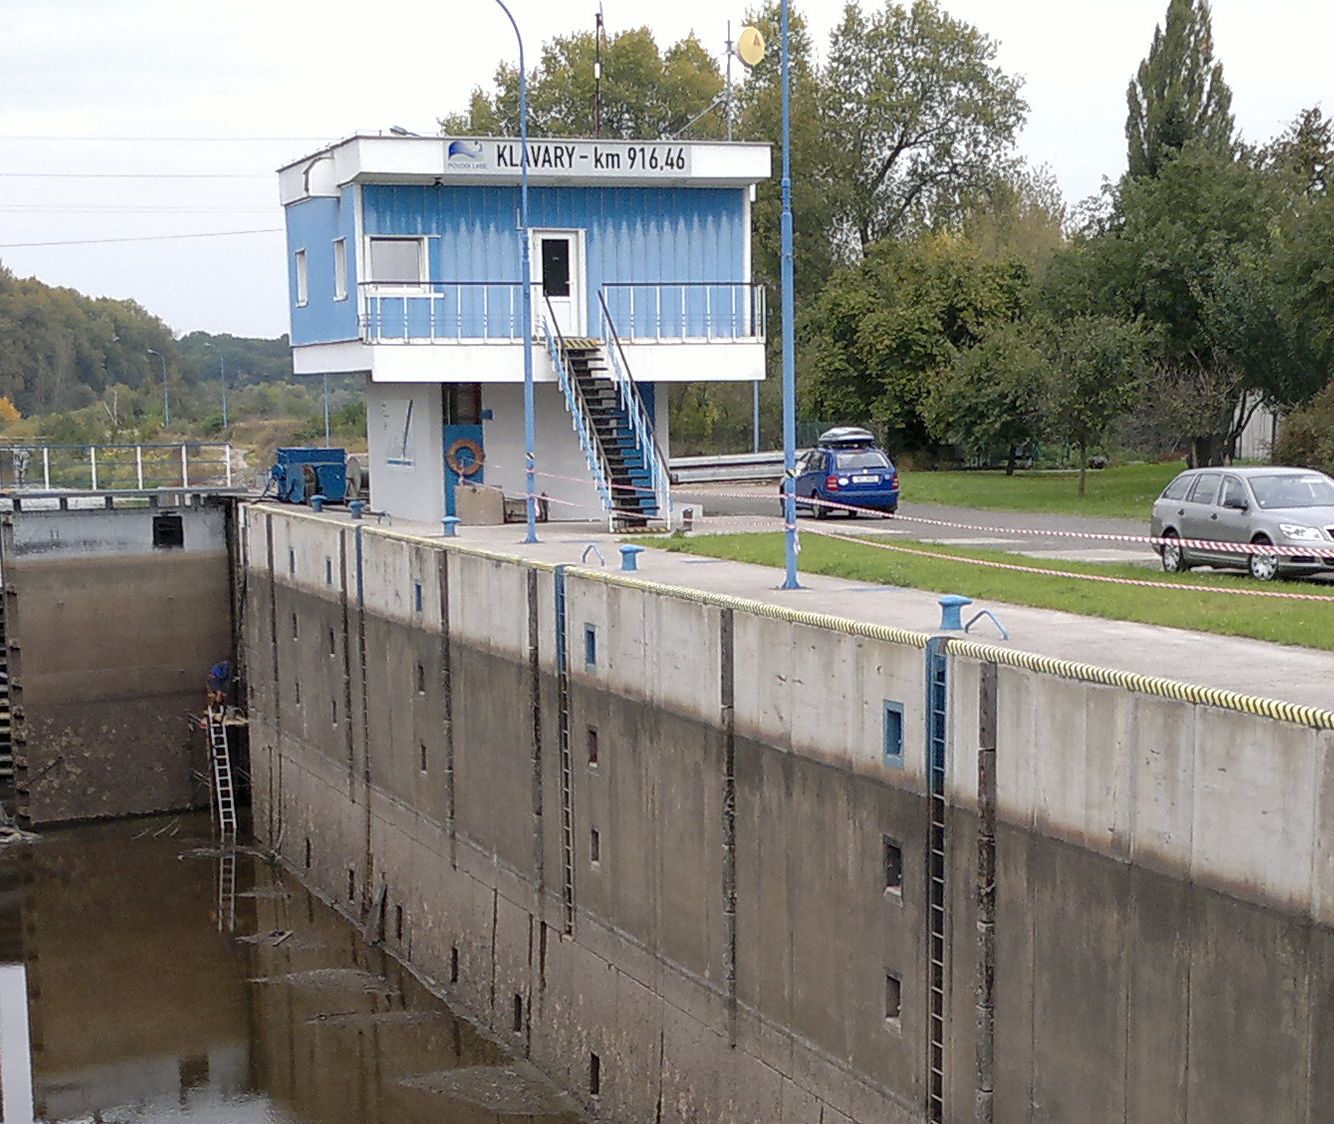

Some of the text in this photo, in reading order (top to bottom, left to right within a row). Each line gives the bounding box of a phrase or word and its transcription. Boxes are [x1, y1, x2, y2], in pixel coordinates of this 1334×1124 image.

[497, 144, 576, 168] KLAVARY
[594, 146, 620, 168] km
[628, 147, 685, 171] 916,46
